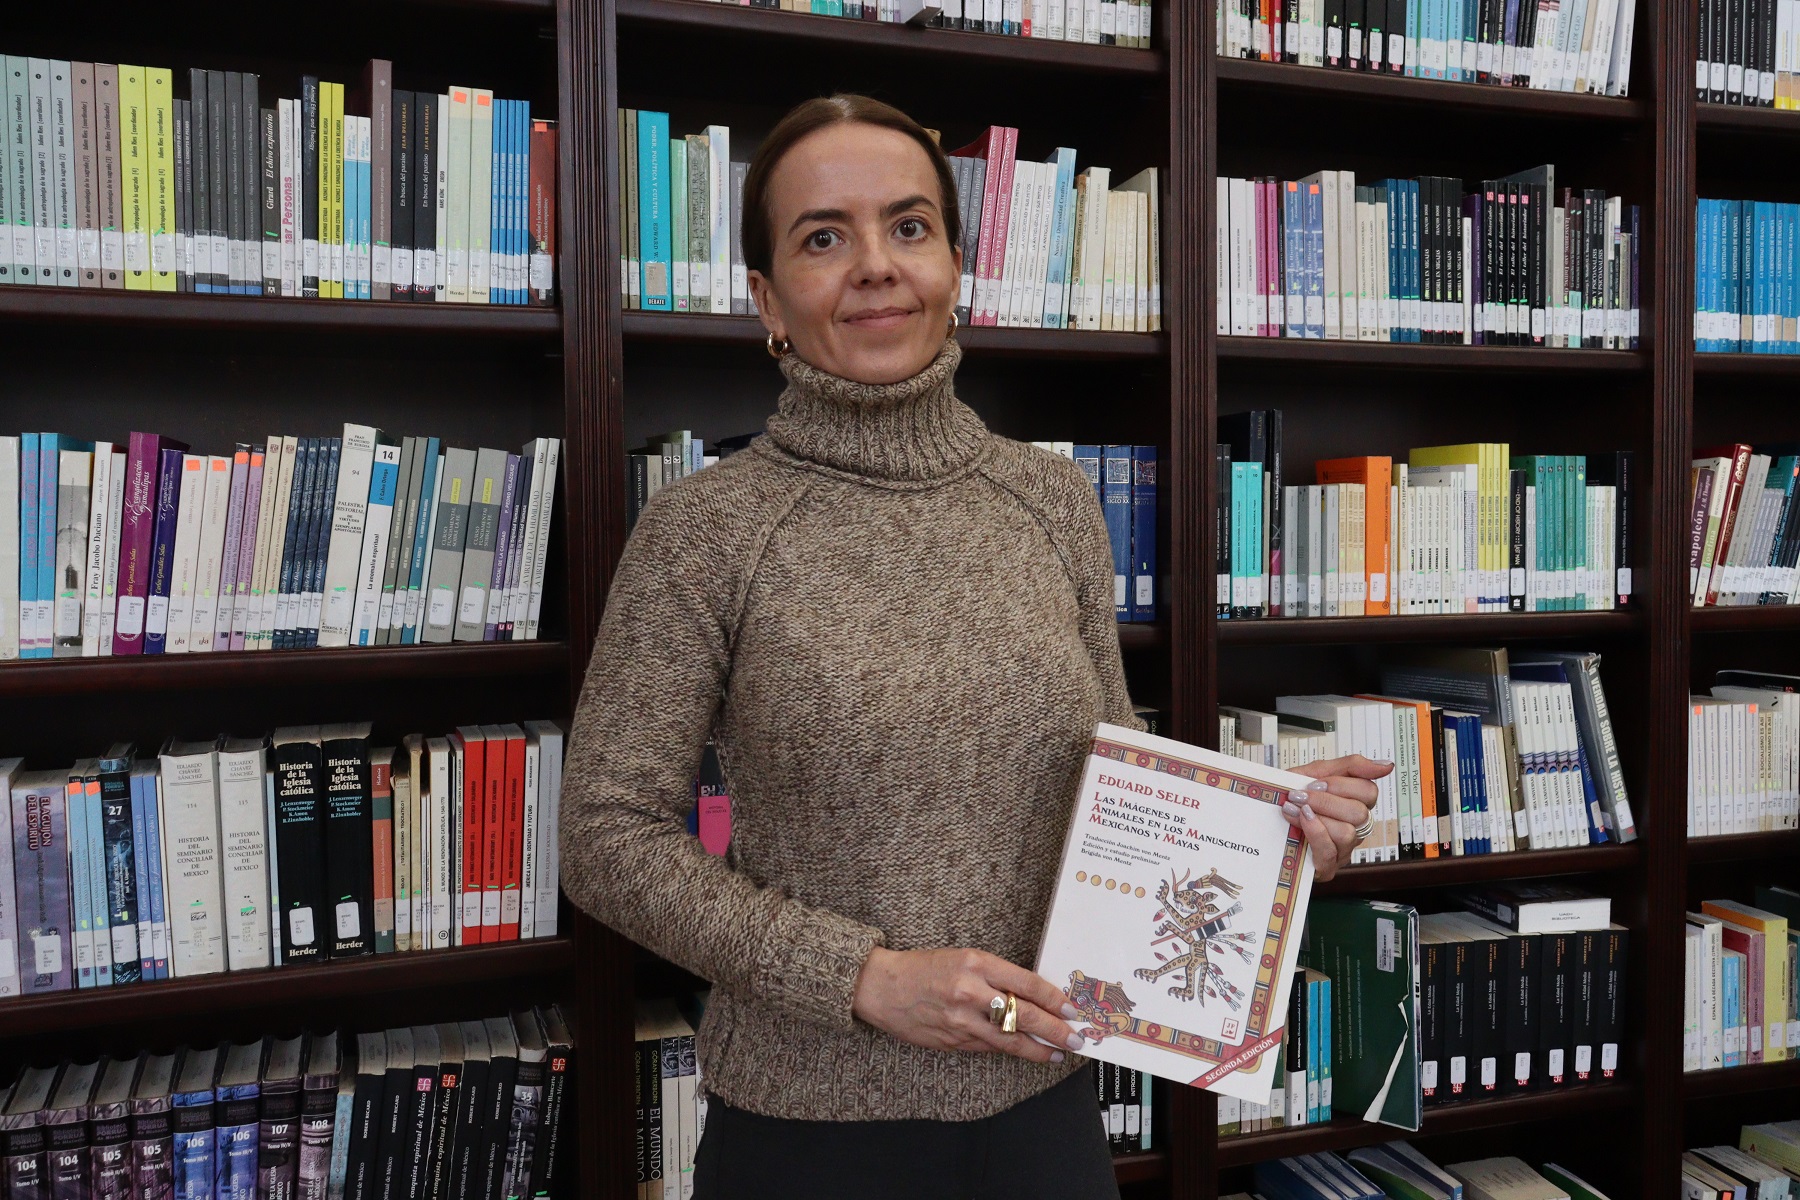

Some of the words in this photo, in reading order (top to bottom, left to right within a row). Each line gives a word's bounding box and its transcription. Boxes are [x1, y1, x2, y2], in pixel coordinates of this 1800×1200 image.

[308, 85, 316, 103] Animal
[266, 113, 275, 150] expiatorio
[36, 134, 44, 146] Julien
[266, 150, 274, 169] chivo
[266, 169, 274, 179] El
[973, 167, 982, 190] mirada
[399, 182, 407, 198] busca
[1058, 181, 1066, 204] Creativa
[266, 186, 274, 210] Girard
[282, 176, 293, 226] Personas
[399, 199, 406, 207] En
[972, 198, 979, 207] en
[1055, 204, 1064, 234] Diversidad
[968, 227, 976, 237] El
[1053, 235, 1062, 257] Nuestra
[647, 298, 666, 306] DEBATE
[381, 450, 394, 461] 14
[381, 468, 390, 483] Ortega
[506, 463, 515, 491] VELÁZQUEZ
[337, 501, 364, 509] PALESTRA
[505, 493, 513, 508] PEDRO
[528, 490, 540, 529] HUMILDAD
[93, 513, 103, 542] Daciano
[446, 507, 457, 547] FUNDAMENTAL
[453, 521, 460, 531] LA
[1689, 510, 1704, 566] Napoleón
[157, 543, 166, 557] Salas
[370, 533, 380, 559] espiritual
[526, 541, 534, 551] DE
[1703, 529, 1716, 566] Josefina
[92, 545, 101, 570] Jacobo
[495, 568, 503, 584] SOCIAL
[499, 530, 507, 552] CARIDAD
[155, 557, 166, 579] González
[367, 559, 377, 581] anomalía
[523, 553, 532, 579] VIRTUD
[90, 572, 101, 590] Fray
[155, 579, 164, 594] Carlos
[367, 581, 374, 590] La
[1590, 678, 1606, 718] VERDAD
[1600, 721, 1615, 754] SOBRE
[278, 761, 314, 771] Historia
[327, 757, 361, 767] Historia
[1607, 755, 1619, 769] LA
[286, 769, 299, 778] de
[299, 769, 307, 778] la
[334, 766, 346, 775] de
[347, 766, 355, 775] la
[282, 777, 312, 789] Iglesia
[328, 782, 362, 792] católica
[330, 774, 359, 785] Iglesia
[1400, 770, 1408, 796] Poder
[1411, 769, 1420, 795] Poder
[279, 786, 315, 797] católica
[1098, 774, 1153, 796] EDUARD
[1155, 789, 1201, 810] SELER
[109, 805, 123, 817] 27
[1094, 791, 1116, 806] LAS
[1118, 797, 1171, 820] IMÁGENES
[1174, 815, 1187, 825] DE
[1088, 814, 1151, 838] MEXICANOS
[1154, 832, 1162, 840] Y
[1162, 833, 1200, 852] MAYAS
[1091, 803, 1145, 825] ANIMALES
[1147, 819, 1162, 829] EN
[1163, 823, 1183, 836] LOS
[1185, 828, 1260, 857] MANUSCRITOS
[178, 835, 211, 844] HISTORIA
[1084, 833, 1116, 846] Traducción
[1116, 842, 1141, 853] Joachim
[1152, 852, 1171, 861] Mentz
[176, 849, 214, 858] SEMINARIO
[176, 855, 215, 864] CONCILIAR
[1082, 840, 1104, 851] Edición
[1109, 848, 1130, 858] estudio
[1130, 853, 1160, 866] preliminar
[1113, 857, 1132, 866] Mentz
[182, 869, 210, 878] MEXICO
[288, 947, 318, 957] Herder
[335, 940, 364, 950] Herder
[1205, 1057, 1243, 1083] SEGUNDA
[1243, 1037, 1274, 1061] EDICIÓN
[416, 1092, 428, 1118] México
[439, 1088, 452, 1114] México
[440, 1116, 448, 1125] de
[649, 1107, 661, 1123] EL
[271, 1124, 289, 1135] 107
[310, 1119, 329, 1130] 108
[417, 1119, 424, 1129] de
[186, 1137, 205, 1148] 106
[232, 1130, 251, 1141] 106
[436, 1126, 447, 1160] espiritual
[142, 1145, 162, 1156] 105
[413, 1130, 423, 1163] espiritual
[649, 1126, 661, 1180] MUNDO
[58, 1155, 79, 1166] 104
[101, 1150, 122, 1162] 105
[16, 1159, 37, 1172] 104
[409, 1165, 419, 1199] conquista
[431, 1161, 443, 1194] conquista
